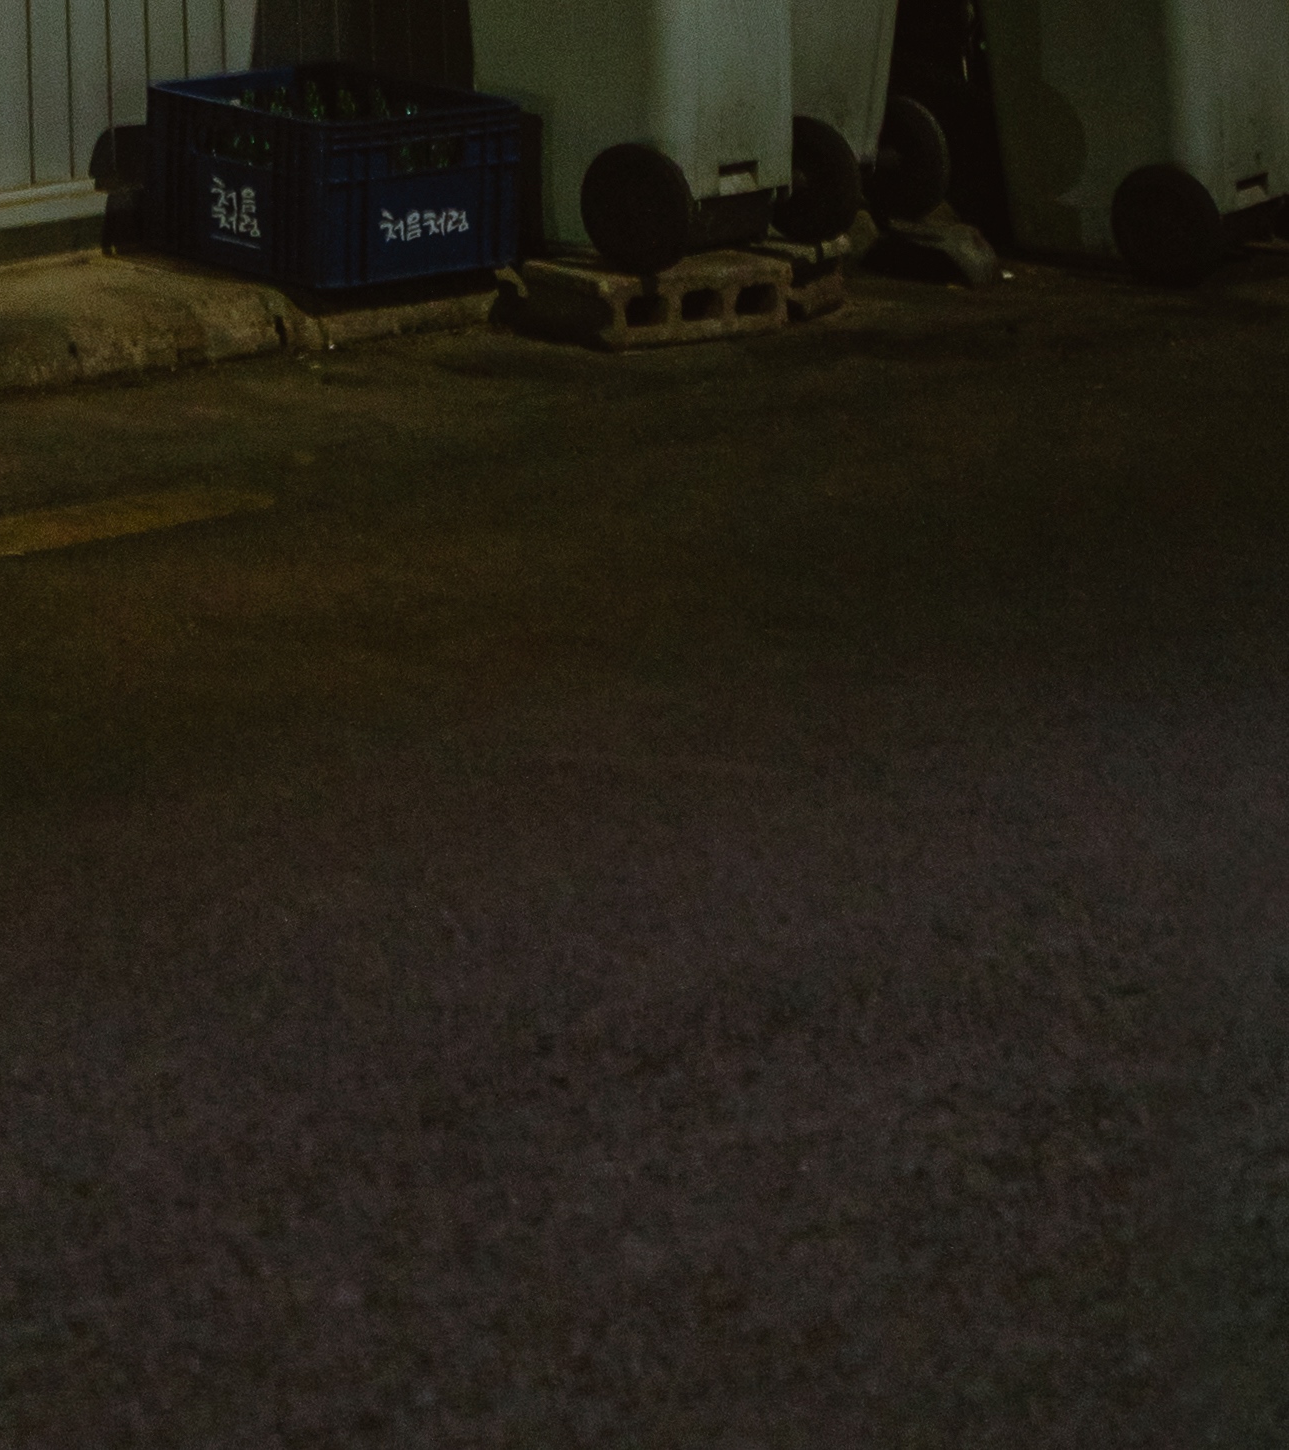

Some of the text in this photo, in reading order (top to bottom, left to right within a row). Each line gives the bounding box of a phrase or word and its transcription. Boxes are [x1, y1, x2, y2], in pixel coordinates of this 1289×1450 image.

[211, 175, 257, 215] 처음
[211, 207, 262, 239] 처럼
[378, 208, 470, 244] 처음처럼
